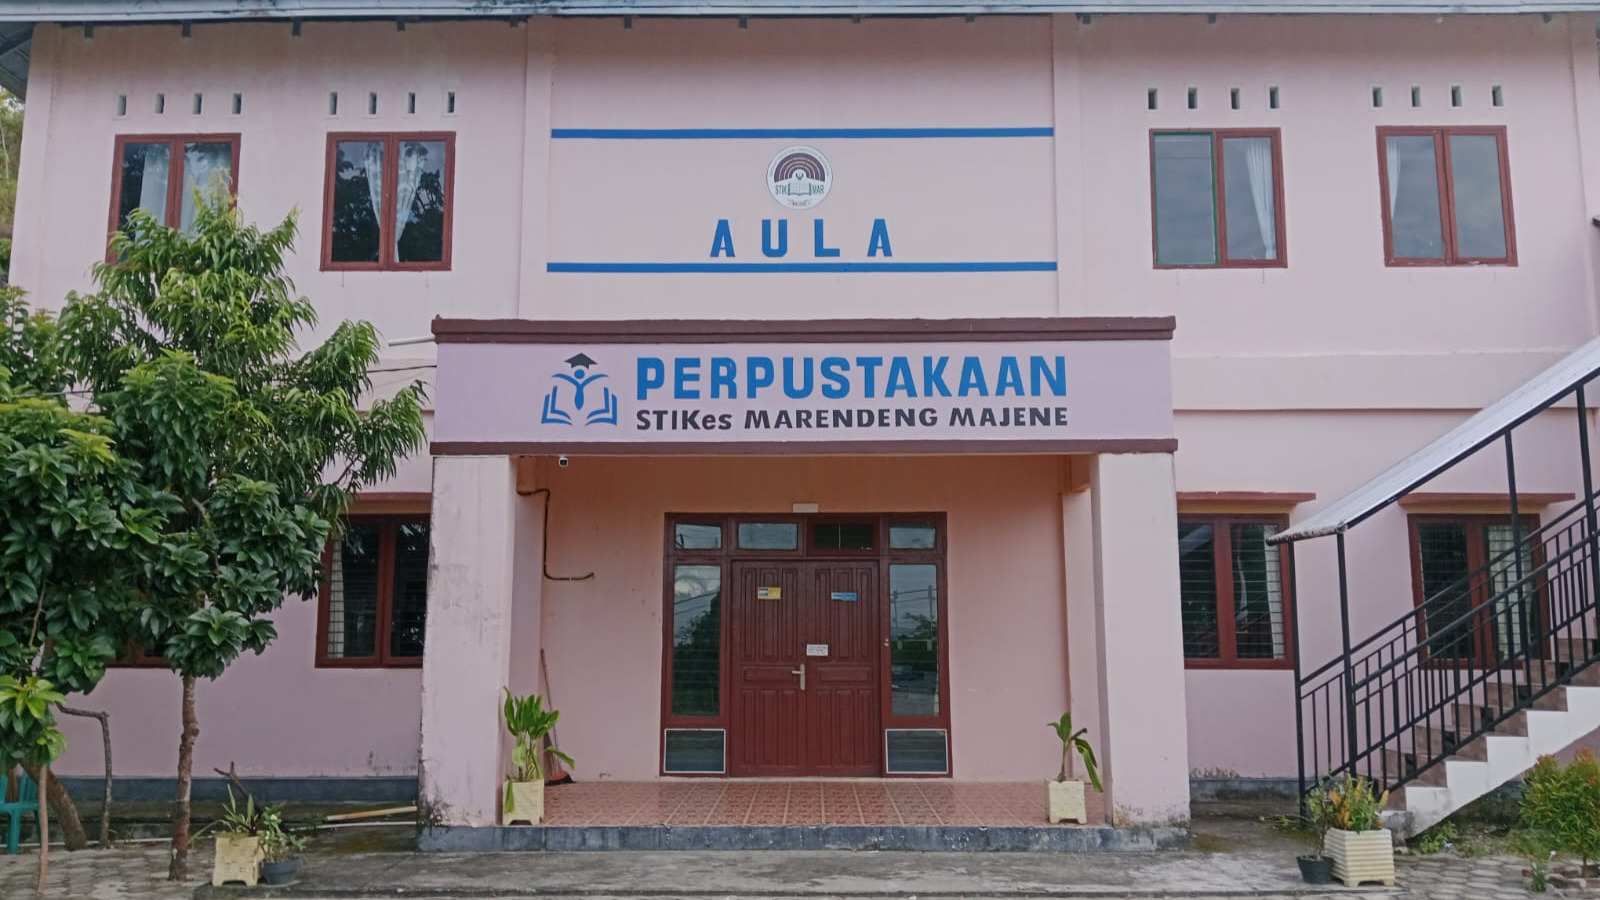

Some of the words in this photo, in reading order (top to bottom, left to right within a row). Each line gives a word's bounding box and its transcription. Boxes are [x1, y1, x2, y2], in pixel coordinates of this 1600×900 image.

[710, 217, 893, 258] AULA
[636, 355, 1067, 401] PERPUSTAKAAN
[636, 409, 733, 431] STIKes
[744, 407, 938, 430] MARENDENG
[949, 407, 1068, 427] MAJENE
